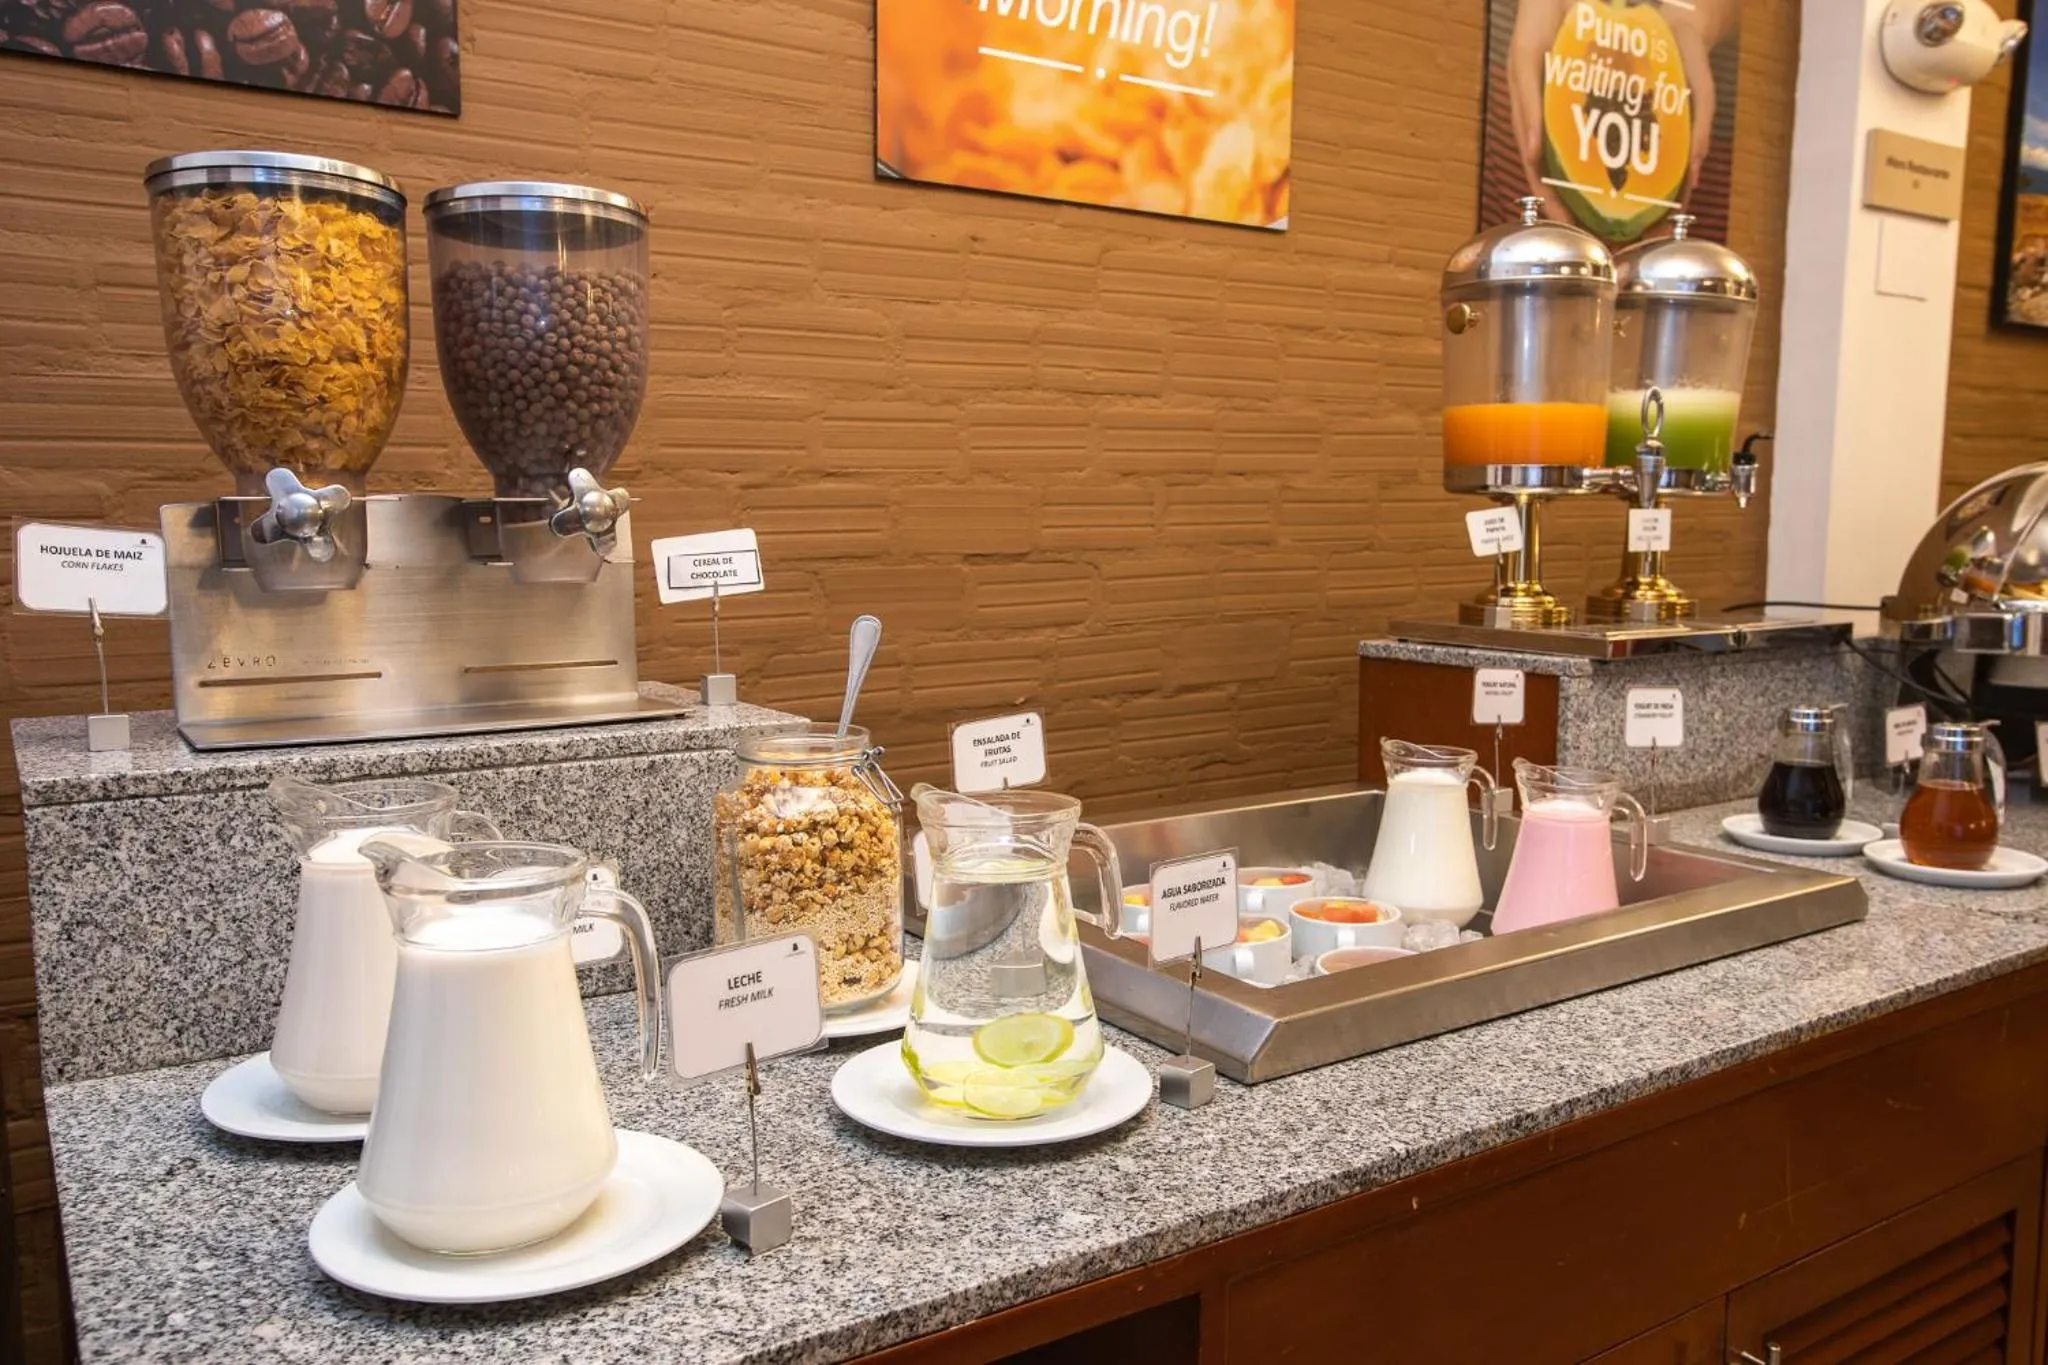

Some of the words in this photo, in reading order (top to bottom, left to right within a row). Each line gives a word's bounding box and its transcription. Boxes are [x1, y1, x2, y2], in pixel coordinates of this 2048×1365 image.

[978, 0, 1218, 69] orning!
[1576, 3, 1647, 56] Puno
[1651, 29, 1668, 63] is
[1544, 51, 1646, 116] waiting
[1653, 72, 1691, 116] for
[1571, 103, 1660, 175] YOU
[40, 545, 93, 558] HOJUELA
[95, 548, 110, 558] DE
[114, 551, 143, 561] MAIZ
[61, 560, 88, 569] CORN
[91, 562, 124, 571] FLAKES
[693, 558, 720, 567] CEREAL
[722, 557, 733, 565] DE
[690, 569, 738, 579] CHOCOLATE
[973, 733, 1010, 747] ENSALADA
[1011, 731, 1021, 740] DE
[984, 745, 1011, 757] FRUTAS
[980, 759, 998, 768] FRUIT
[1161, 886, 1182, 900] AGUA
[1183, 877, 1227, 894] SABORIZADA
[1169, 898, 1199, 912] FLAVORED
[1200, 893, 1219, 905] WATER
[573, 923, 594, 934] MILK
[727, 971, 762, 990] LECHE
[718, 993, 748, 1011] FRESH
[750, 987, 774, 1003] MILK
